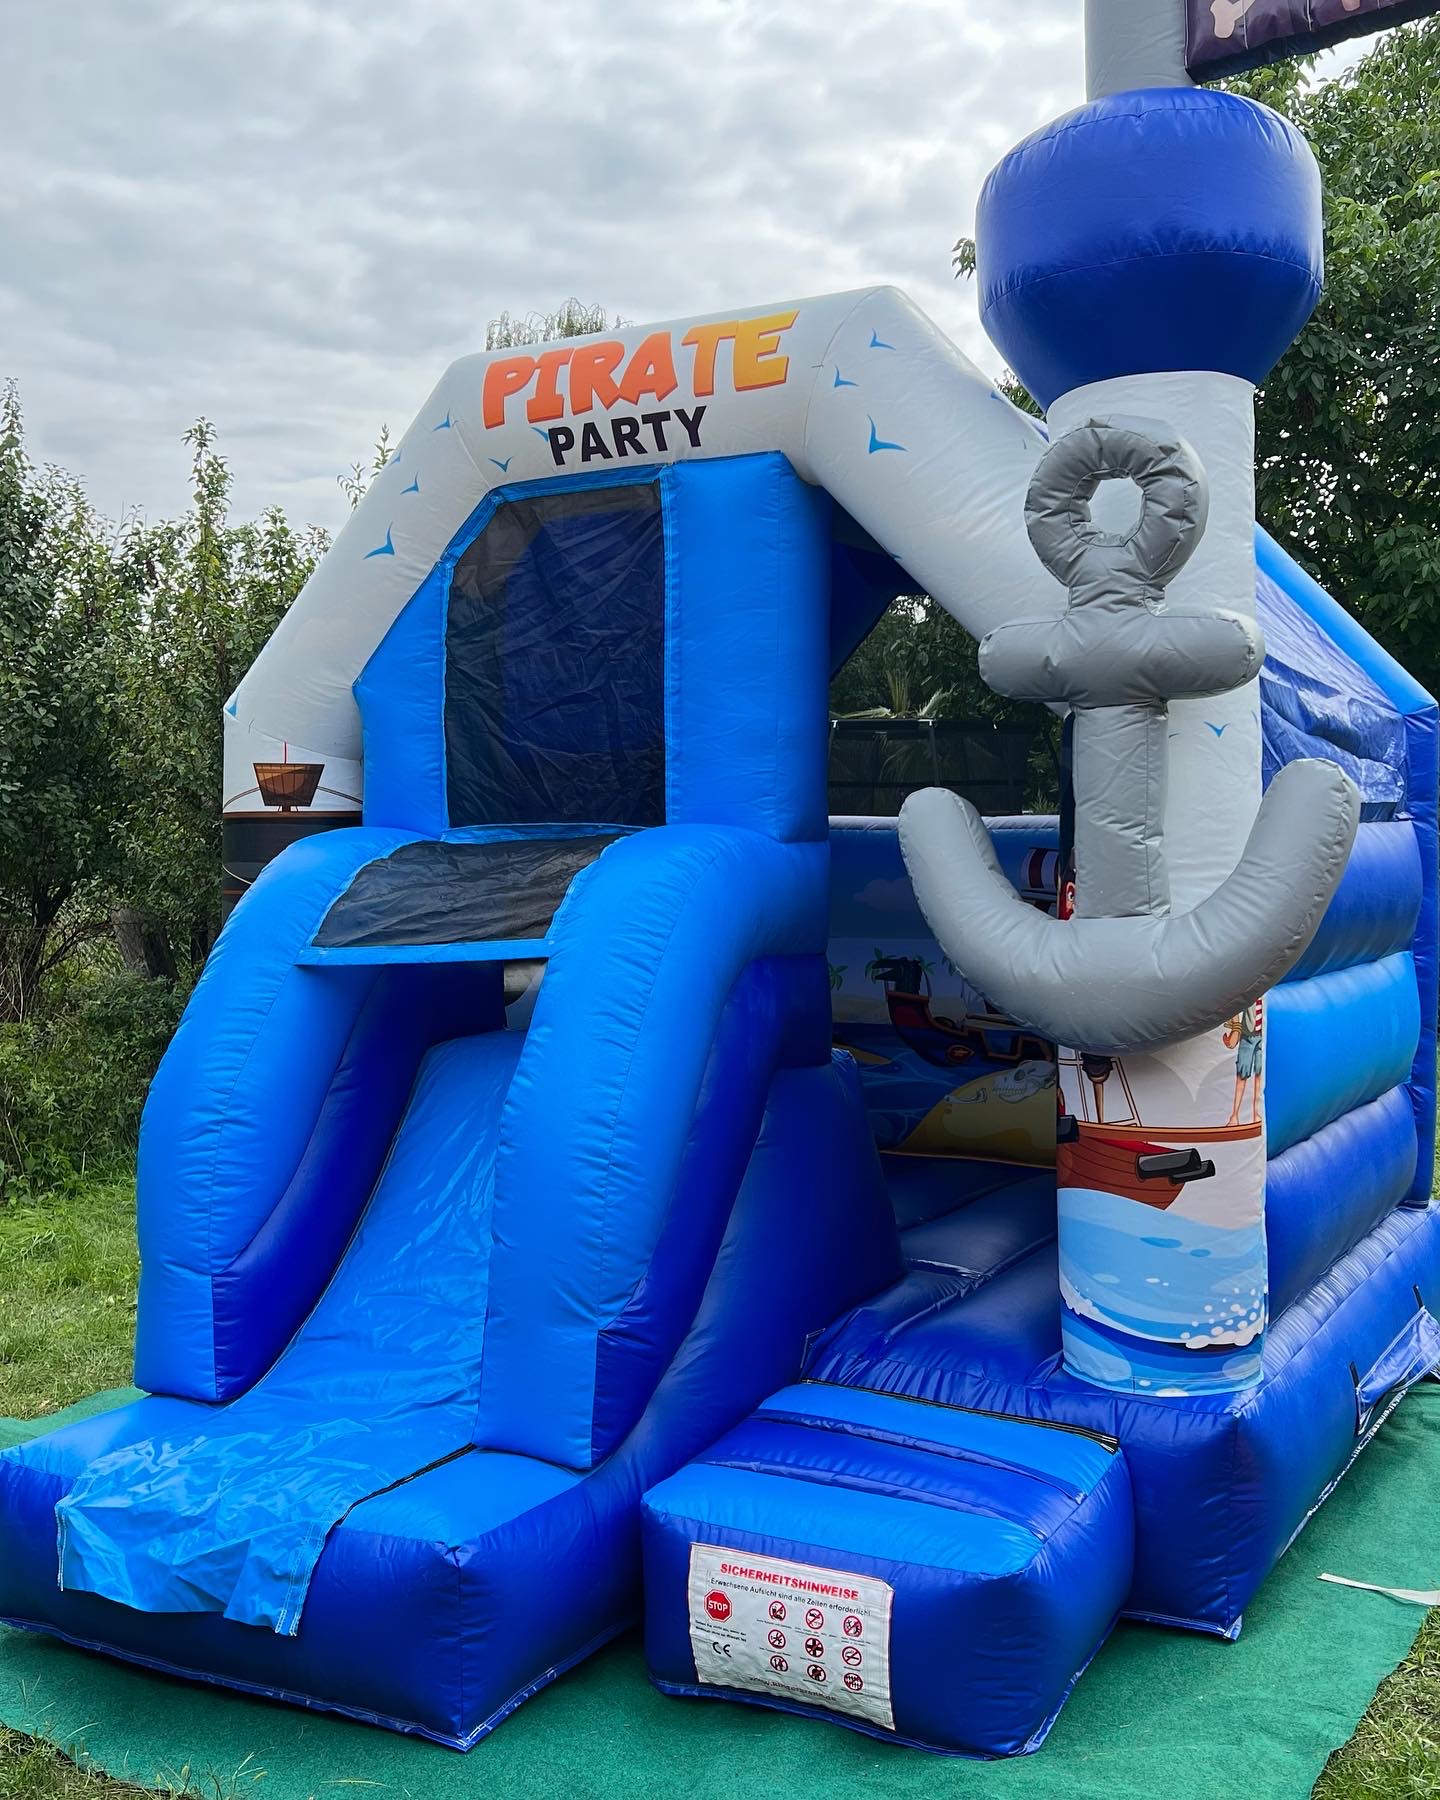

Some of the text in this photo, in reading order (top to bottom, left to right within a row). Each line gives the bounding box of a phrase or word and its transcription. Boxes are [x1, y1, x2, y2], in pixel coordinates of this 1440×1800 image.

[482, 310, 801, 430] PIRATE
[547, 405, 707, 466] PARTY
[710, 1577, 749, 1592] Erwachsene
[749, 1586, 777, 1598] Aufsicht
[778, 1592, 793, 1601] sind
[793, 1595, 806, 1604] alle
[720, 1563, 859, 1600] SICHERHEITSHINWEISE
[707, 1600, 729, 1612] STOP
[712, 1641, 732, 1658] CE
